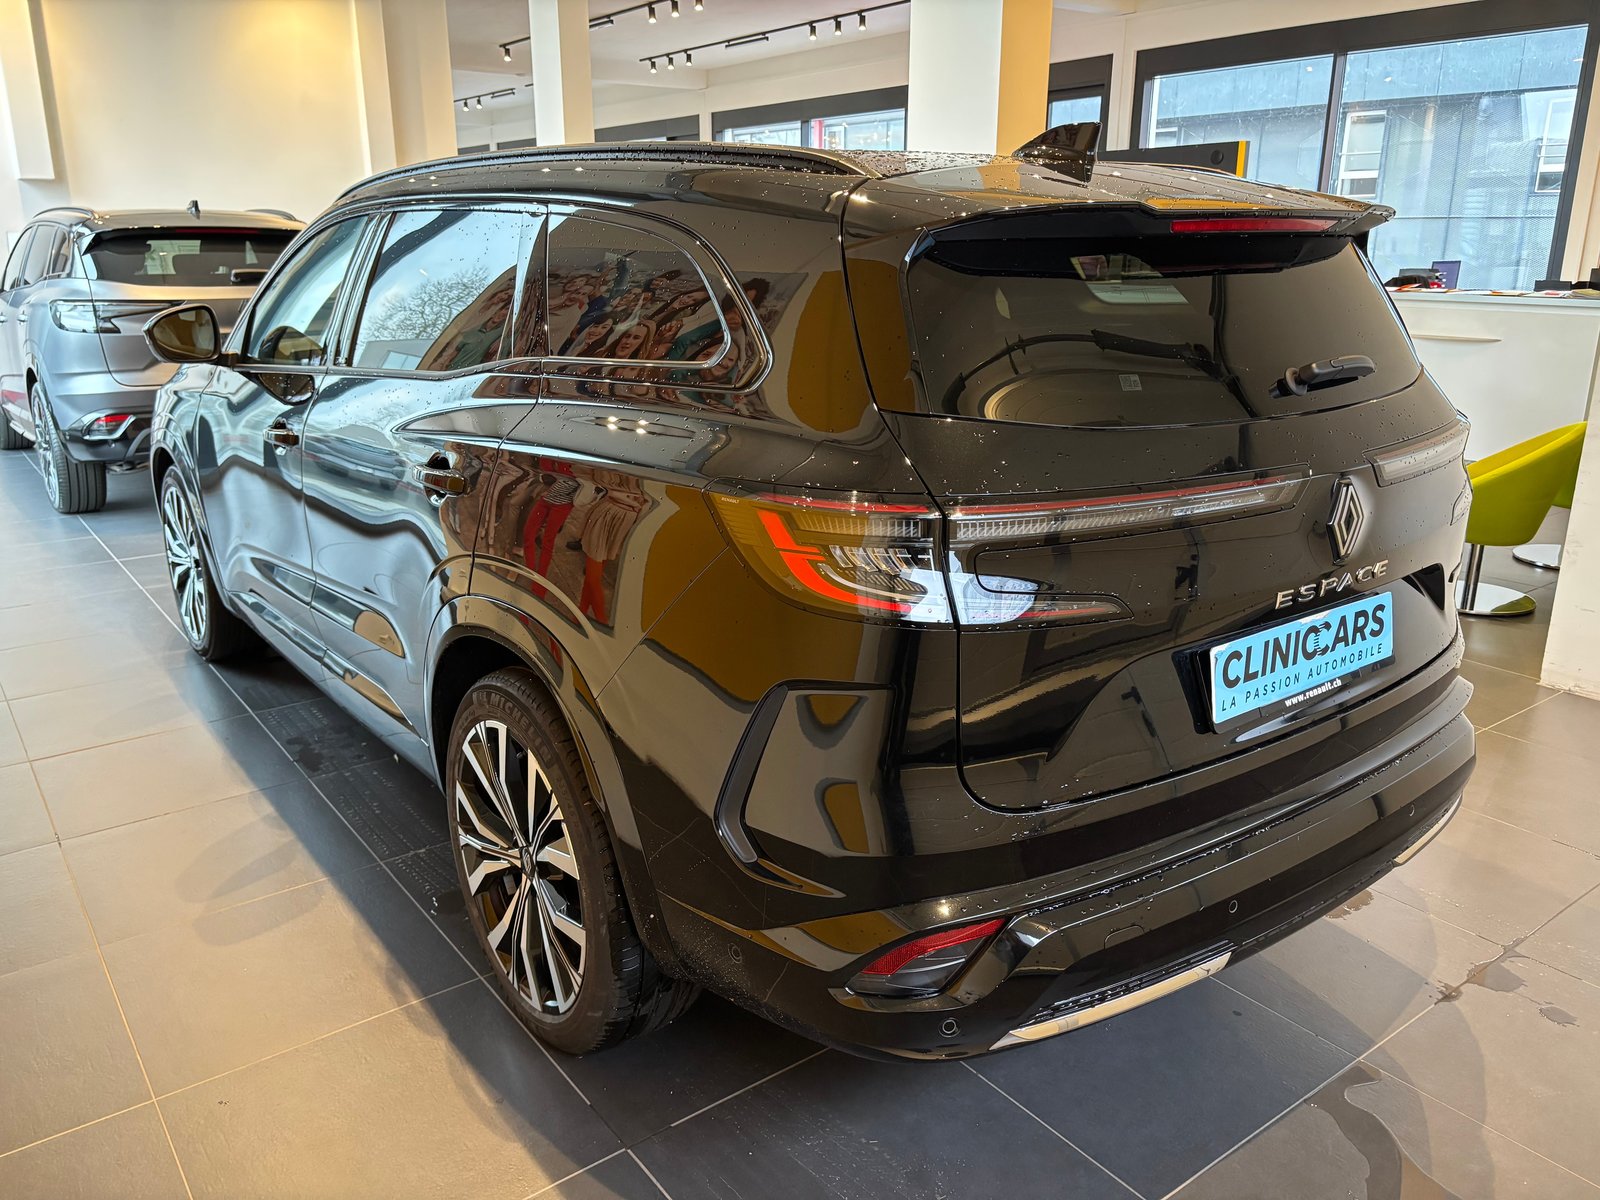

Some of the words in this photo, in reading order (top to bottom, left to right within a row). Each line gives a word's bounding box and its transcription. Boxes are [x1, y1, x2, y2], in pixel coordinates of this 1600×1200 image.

[1275, 559, 1389, 610] ESPACE
[1221, 696, 1237, 712] LA
[1245, 672, 1300, 703] PASSION
[1307, 643, 1383, 680] AUTOMOBILE
[1284, 678, 1342, 708] www.renault.ch
[489, 692, 553, 764] MICHELIN
